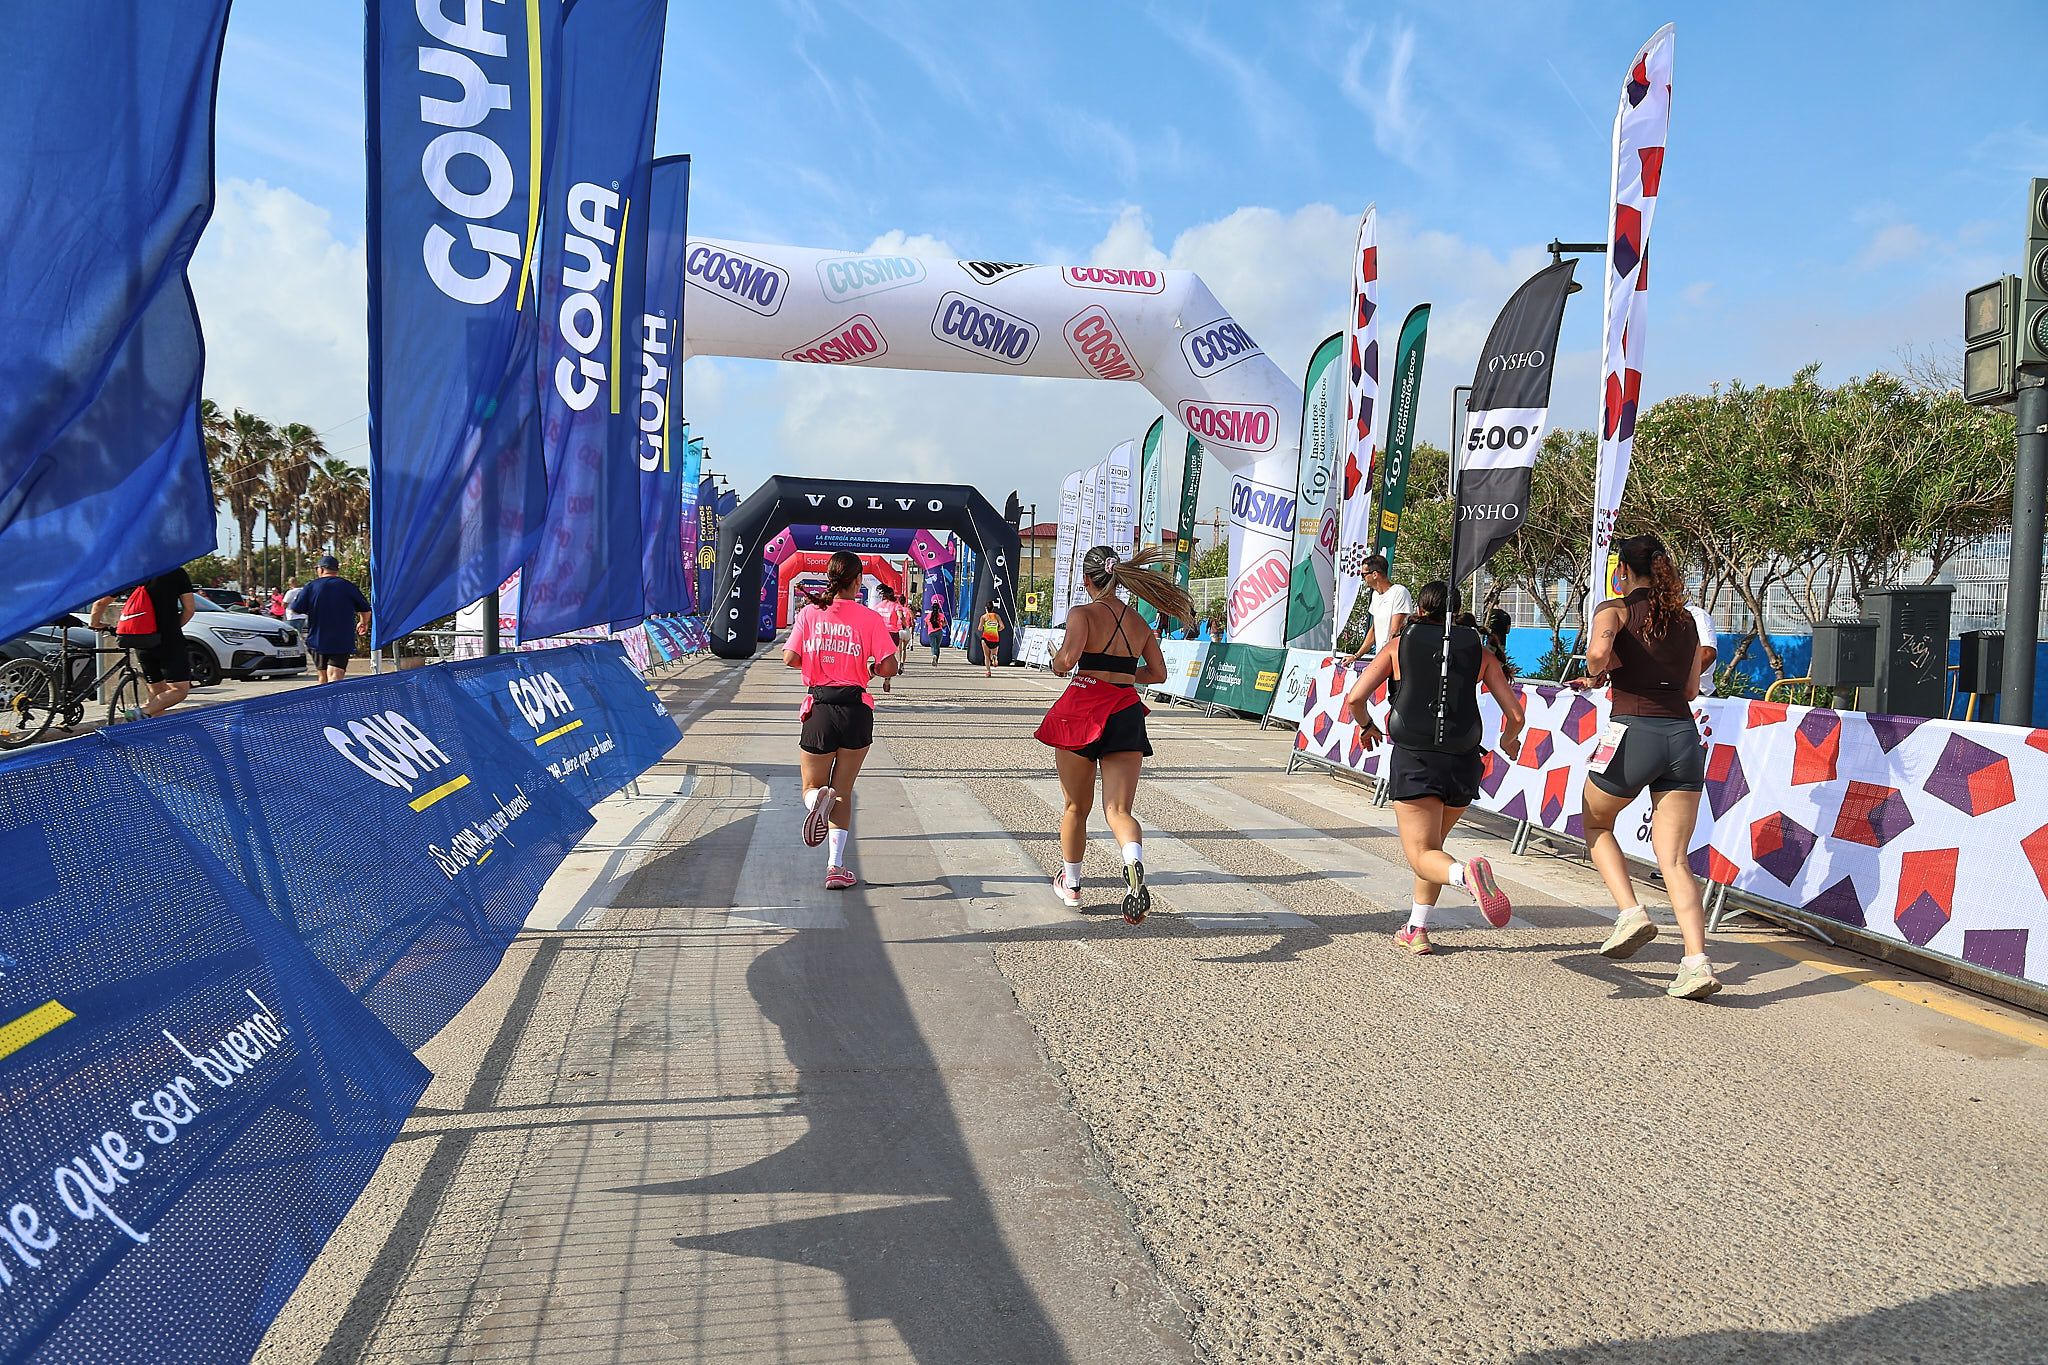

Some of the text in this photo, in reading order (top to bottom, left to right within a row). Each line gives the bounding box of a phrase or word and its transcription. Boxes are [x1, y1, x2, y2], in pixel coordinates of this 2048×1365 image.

[415, 0, 522, 305] GOYA
[555, 181, 620, 412] GOYA
[686, 246, 780, 307] COSMO
[826, 257, 916, 295] COSMO
[941, 299, 1030, 359] COSMO
[1191, 322, 1259, 369] COSM
[1488, 350, 1545, 373] OYSHO
[1186, 405, 1270, 445] COSMO
[1311, 404, 1320, 461] Institutos
[1319, 377, 1330, 461] Odontológicos
[805, 493, 943, 512] VOLVO
[1231, 482, 1296, 533] COSMO
[727, 542, 744, 642] VOLVO
[1229, 558, 1289, 628] COSMO
[508, 671, 575, 733] GOYA
[322, 709, 450, 793] GOYA
[162, 988, 289, 1087] bueno!
[131, 1075, 201, 1144] ser
[54, 1131, 149, 1244] que
